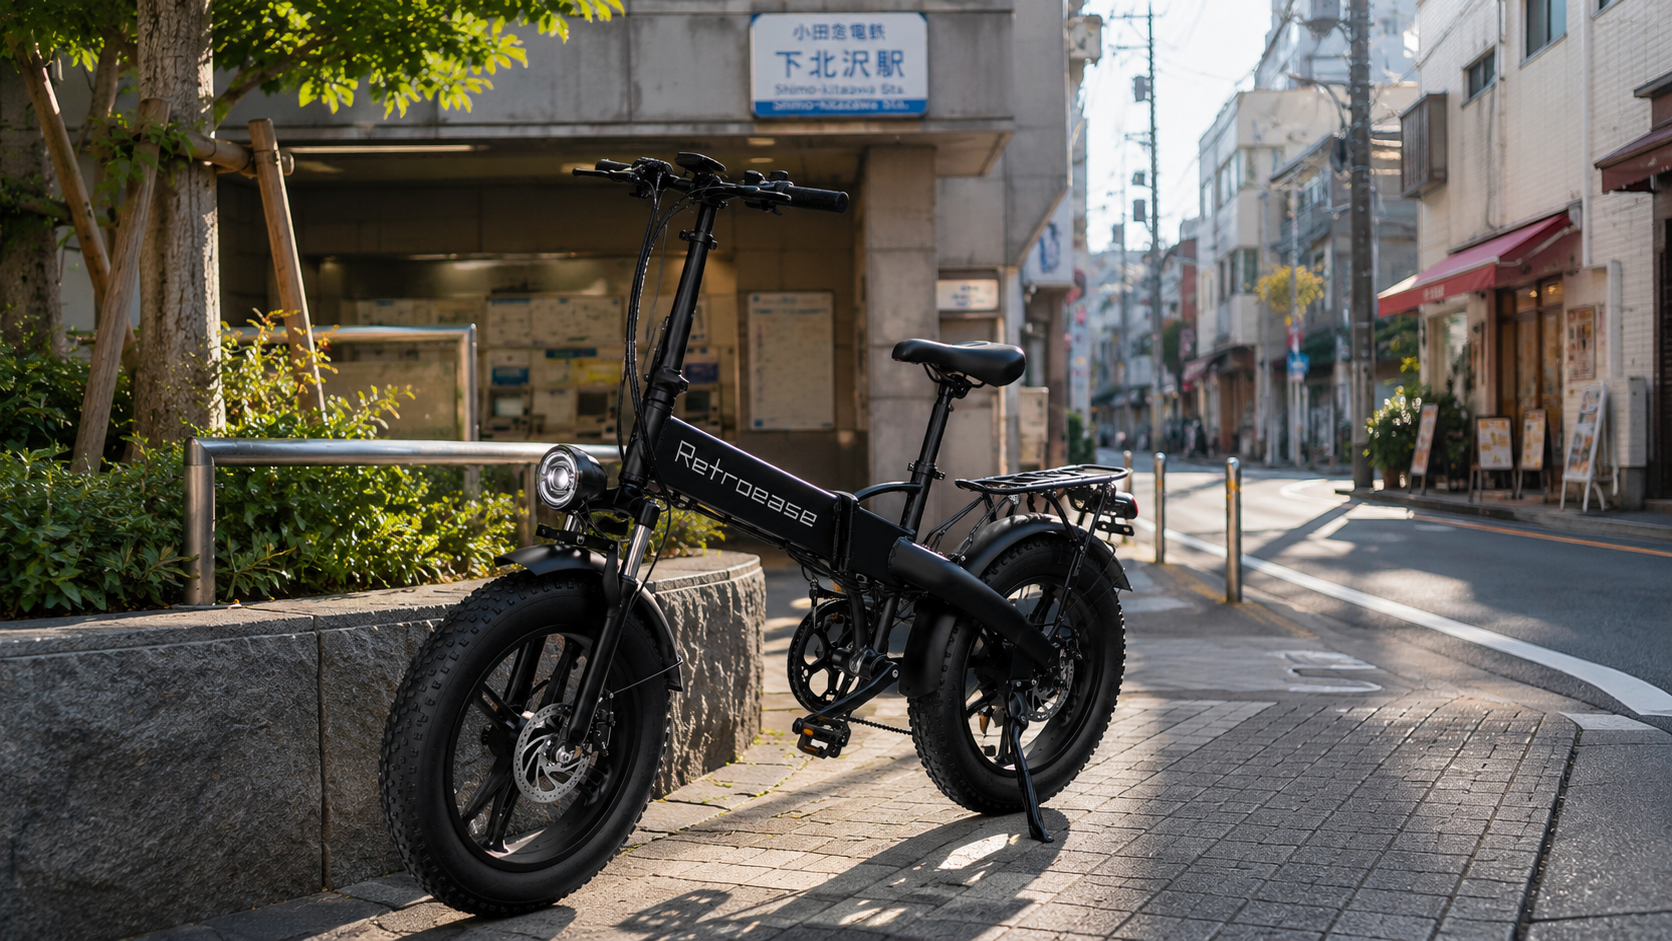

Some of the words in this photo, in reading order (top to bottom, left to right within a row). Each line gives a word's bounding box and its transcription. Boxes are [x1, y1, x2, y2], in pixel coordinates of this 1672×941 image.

[775, 50, 905, 78] 下北沢駅
[675, 440, 817, 527] Retroease
